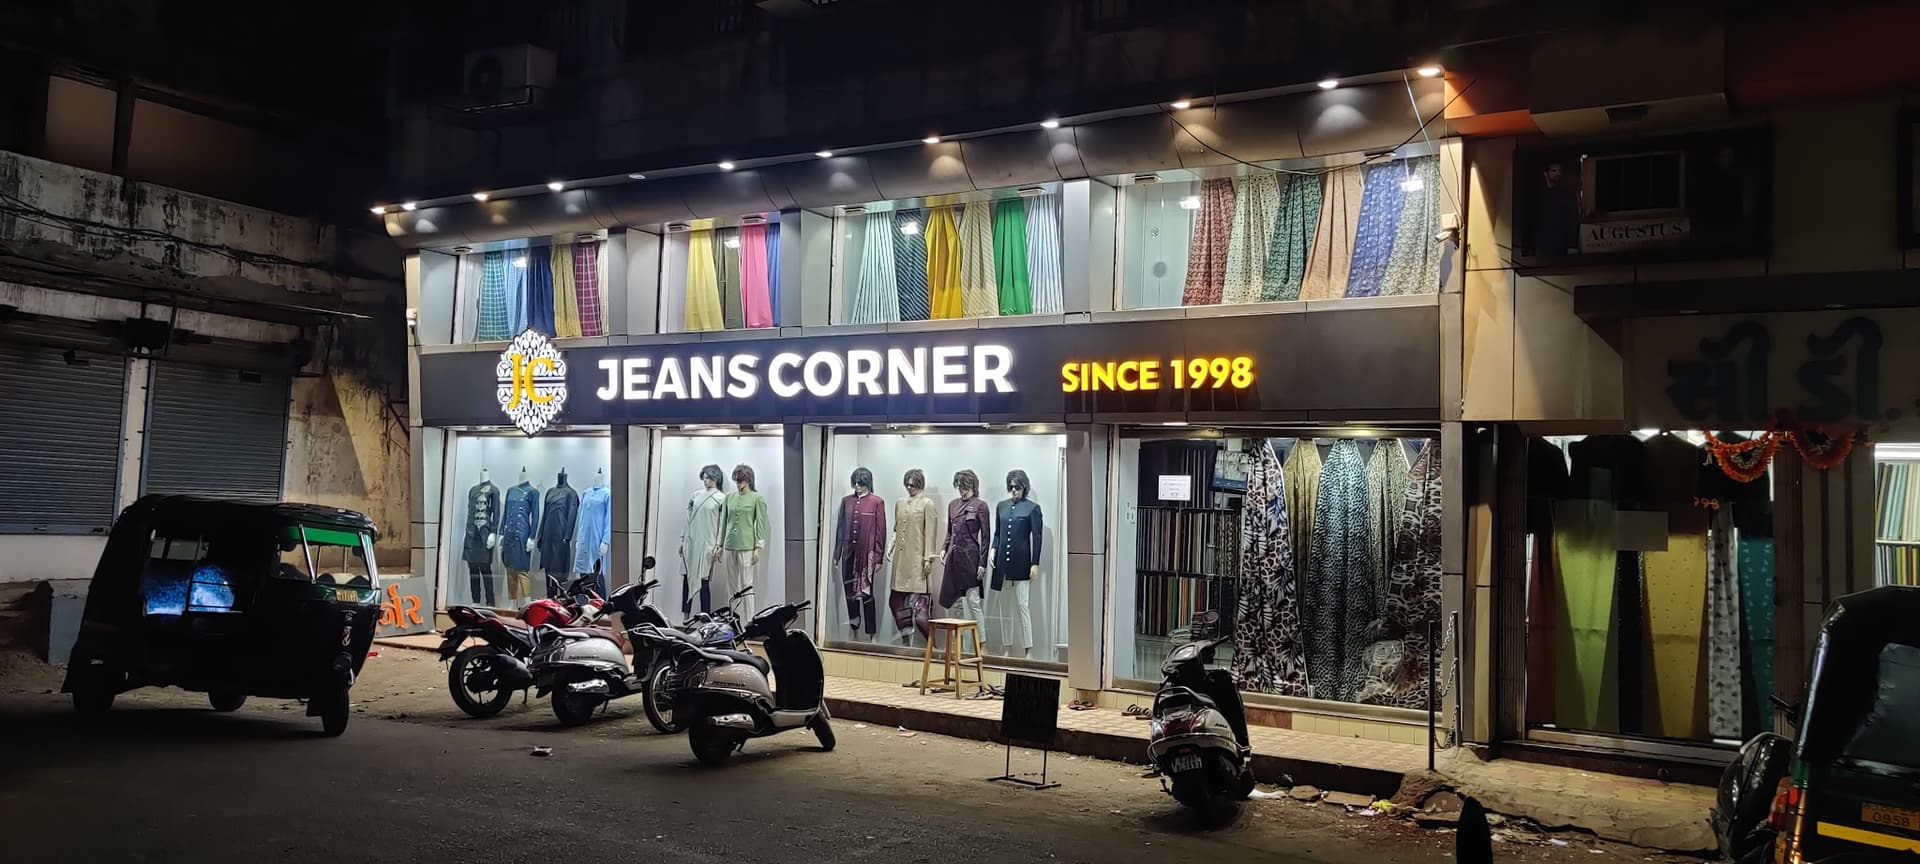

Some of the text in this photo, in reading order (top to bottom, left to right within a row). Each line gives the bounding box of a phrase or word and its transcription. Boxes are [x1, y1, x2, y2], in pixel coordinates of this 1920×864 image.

[1592, 222, 1683, 240] AUGUSTUS
[508, 352, 555, 410] JC
[597, 344, 1016, 400] JEANS CORNER
[1062, 357, 1254, 392] SINCE 1998
